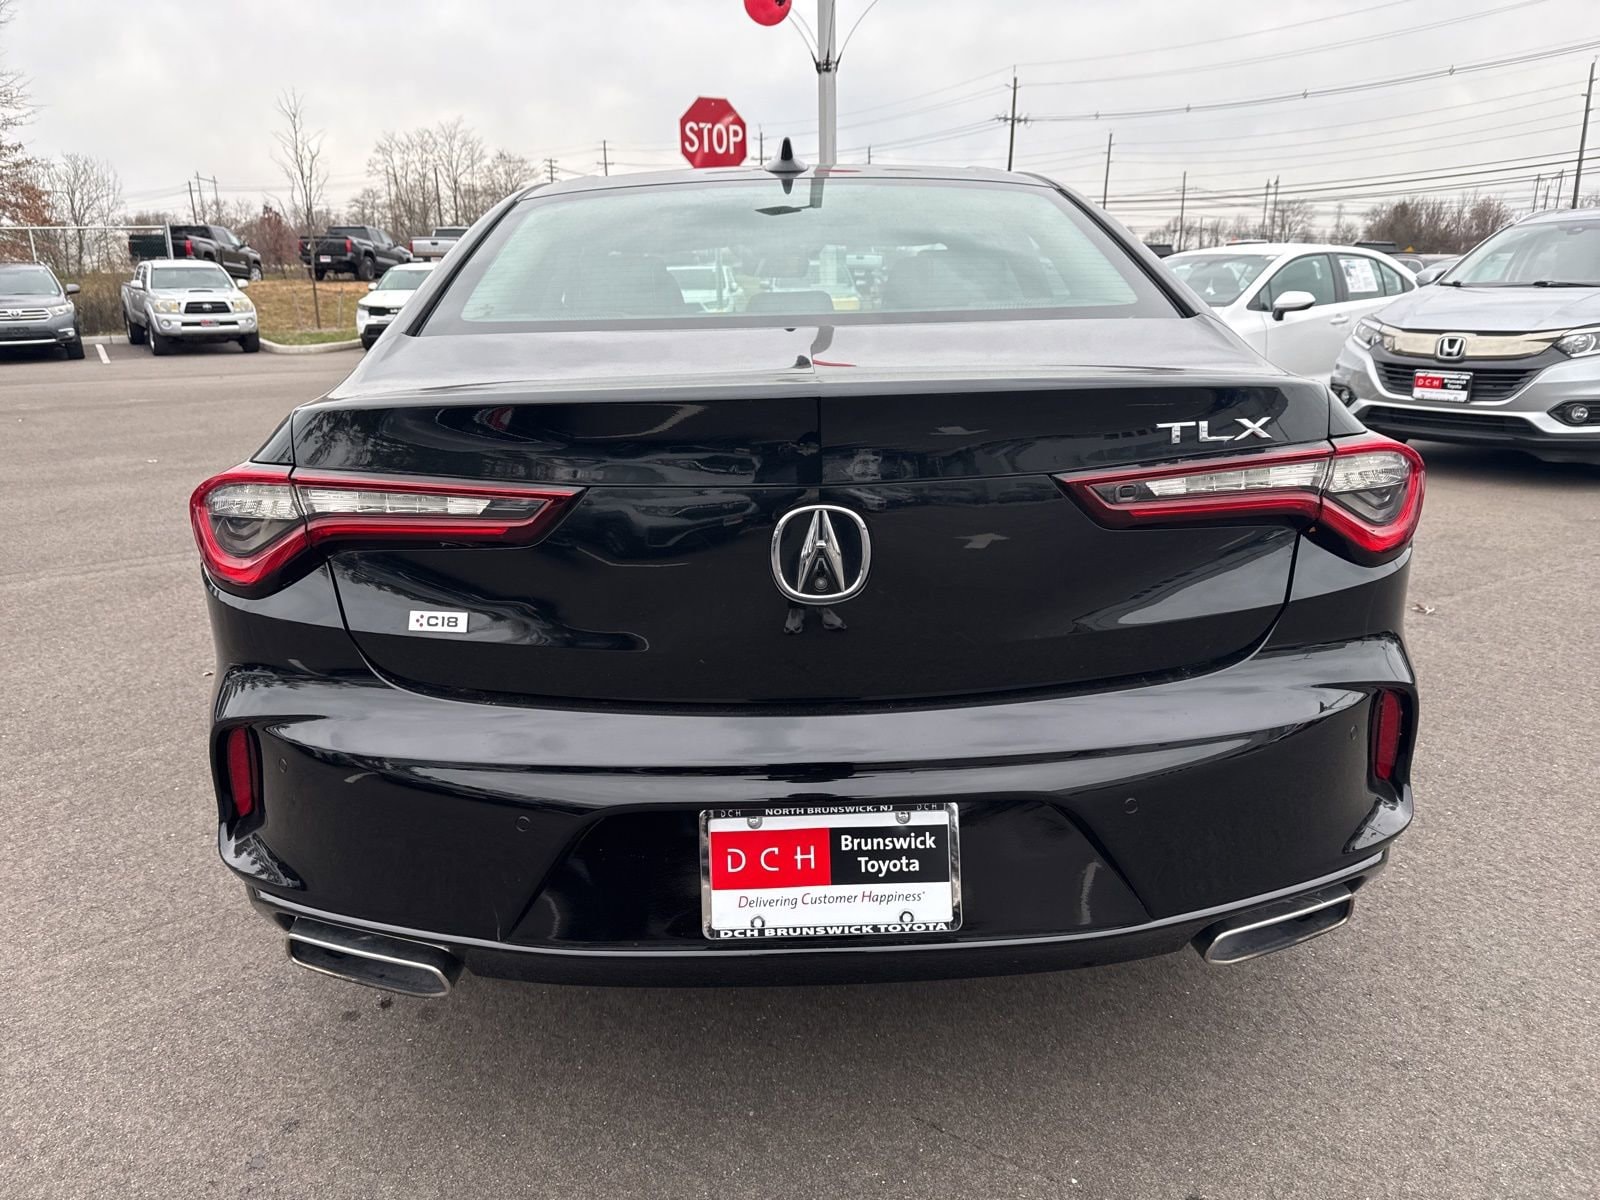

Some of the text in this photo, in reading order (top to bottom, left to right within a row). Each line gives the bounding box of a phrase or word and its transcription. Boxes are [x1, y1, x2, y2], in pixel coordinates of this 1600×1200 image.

[684, 121, 744, 155] STOP
[1156, 416, 1273, 444] TLX
[765, 808, 804, 816] NORTH
[880, 804, 894, 812] NJ
[840, 832, 937, 851] Brunswick
[857, 856, 920, 878] Toyota
[738, 896, 798, 910] Delivering
[801, 892, 858, 906] Customer
[719, 922, 948, 938] DCH BRUNSWICK TOYOTA
